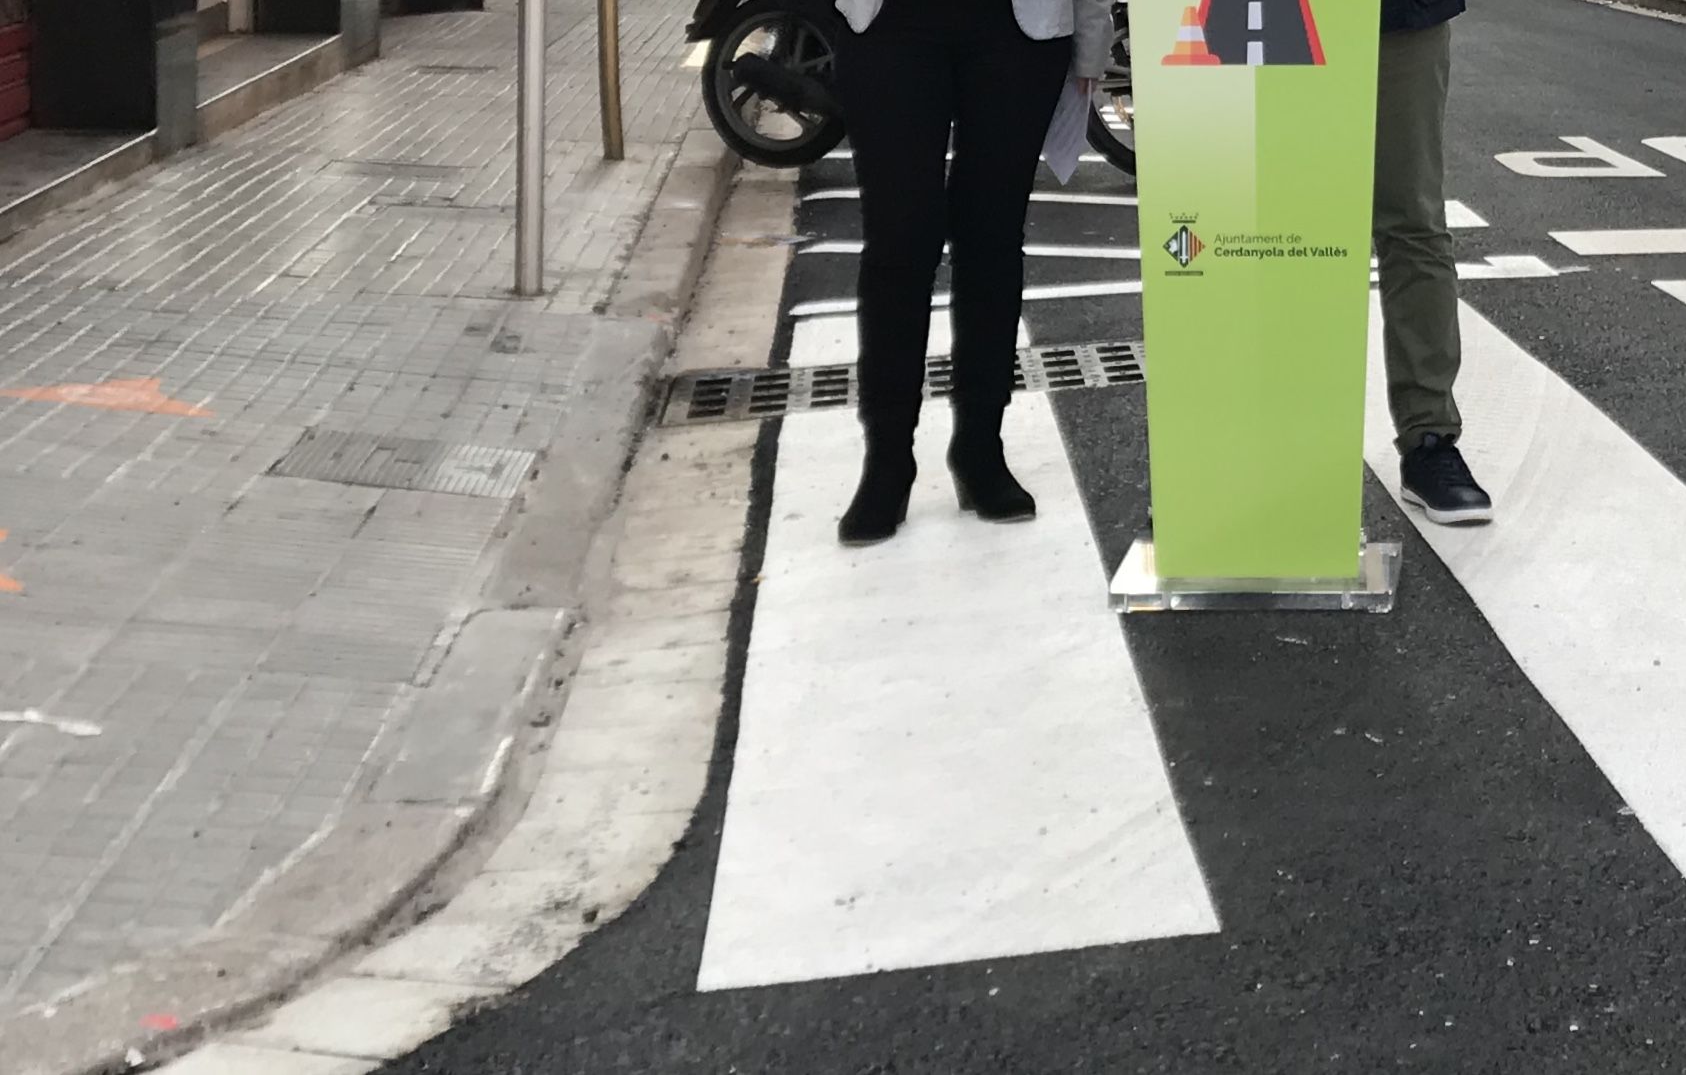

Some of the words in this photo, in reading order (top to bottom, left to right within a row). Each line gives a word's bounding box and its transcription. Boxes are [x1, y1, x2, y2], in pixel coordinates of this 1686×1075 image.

[1214, 233, 1283, 246] Ajuntament
[1286, 233, 1302, 244] de
[1214, 246, 1285, 260] Cerdanyola
[1288, 246, 1308, 257] del
[1310, 246, 1348, 257] Vallès
